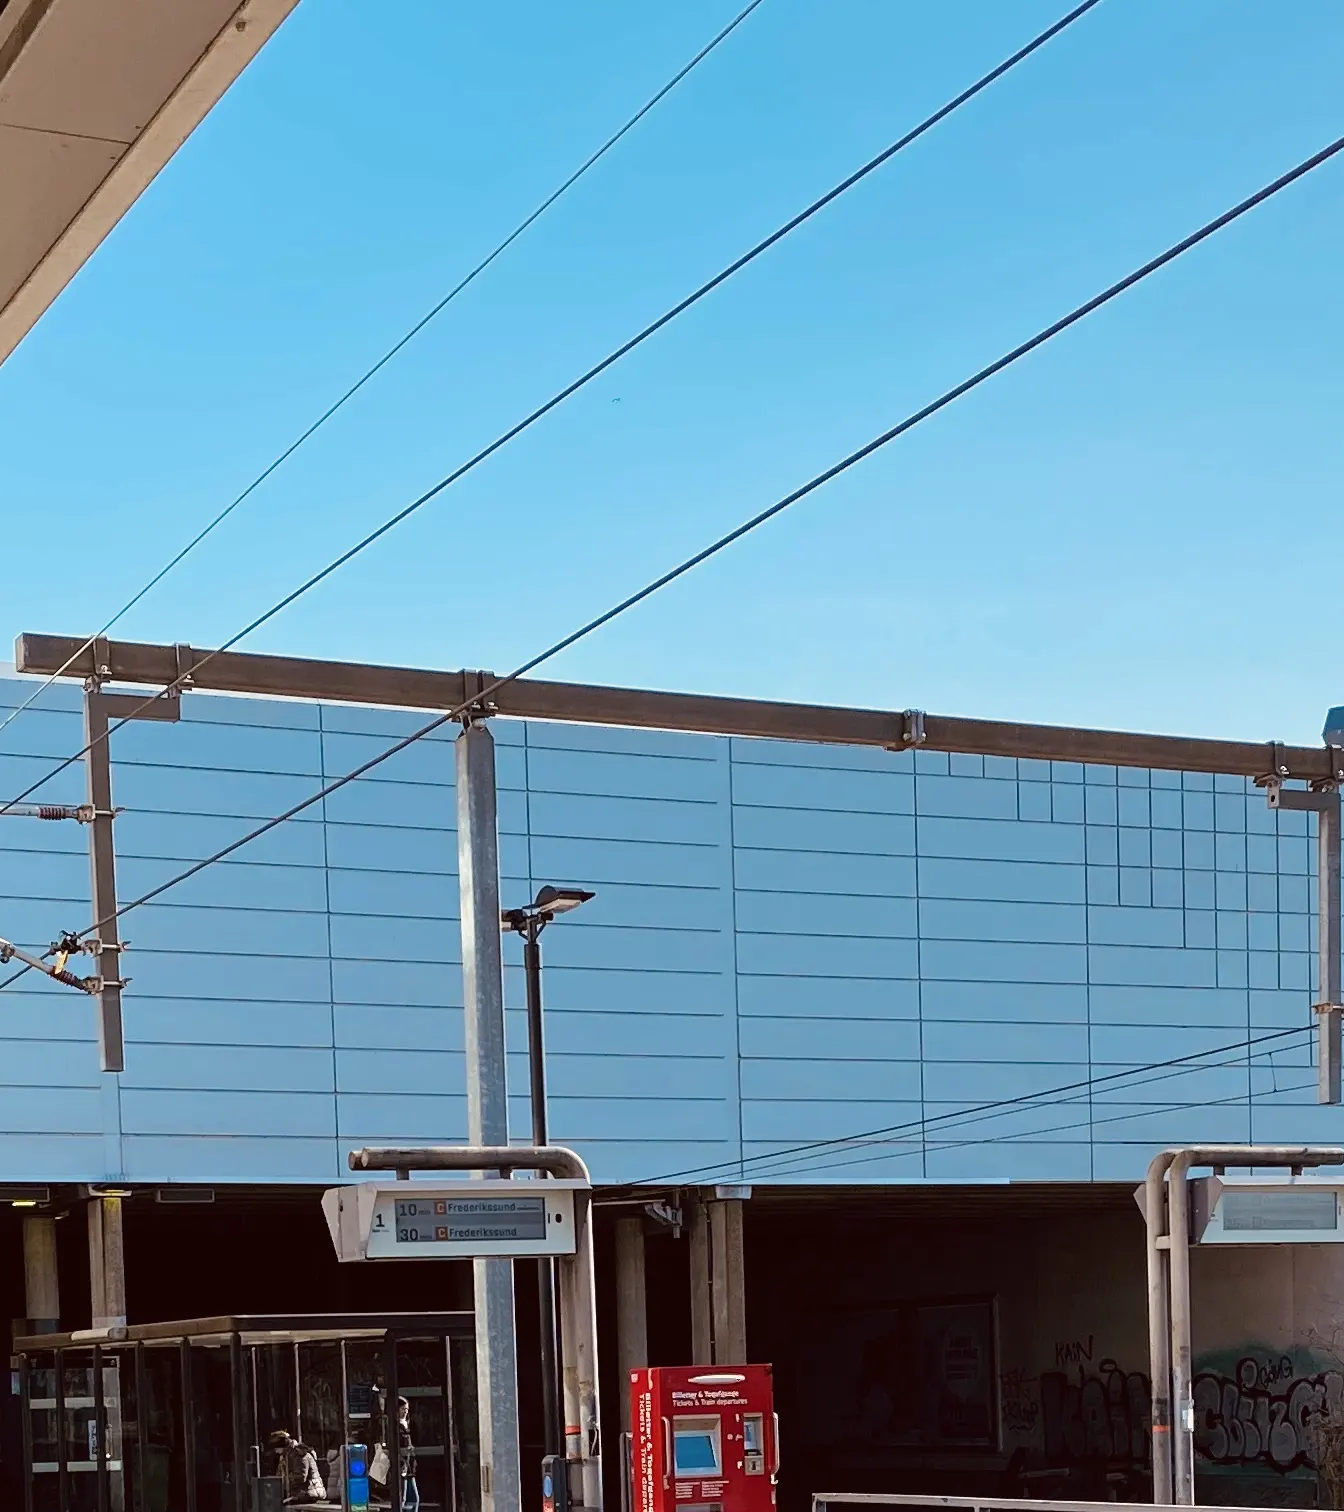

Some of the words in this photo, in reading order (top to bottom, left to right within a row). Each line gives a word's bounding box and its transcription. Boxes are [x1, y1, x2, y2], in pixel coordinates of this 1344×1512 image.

[399, 1203, 417, 1217] 10
[448, 1202, 516, 1213] Frederikssund
[375, 1213, 385, 1227] 1
[400, 1228, 418, 1241] 30
[449, 1227, 517, 1238] Frederikssund
[640, 1448, 648, 1475] Train
